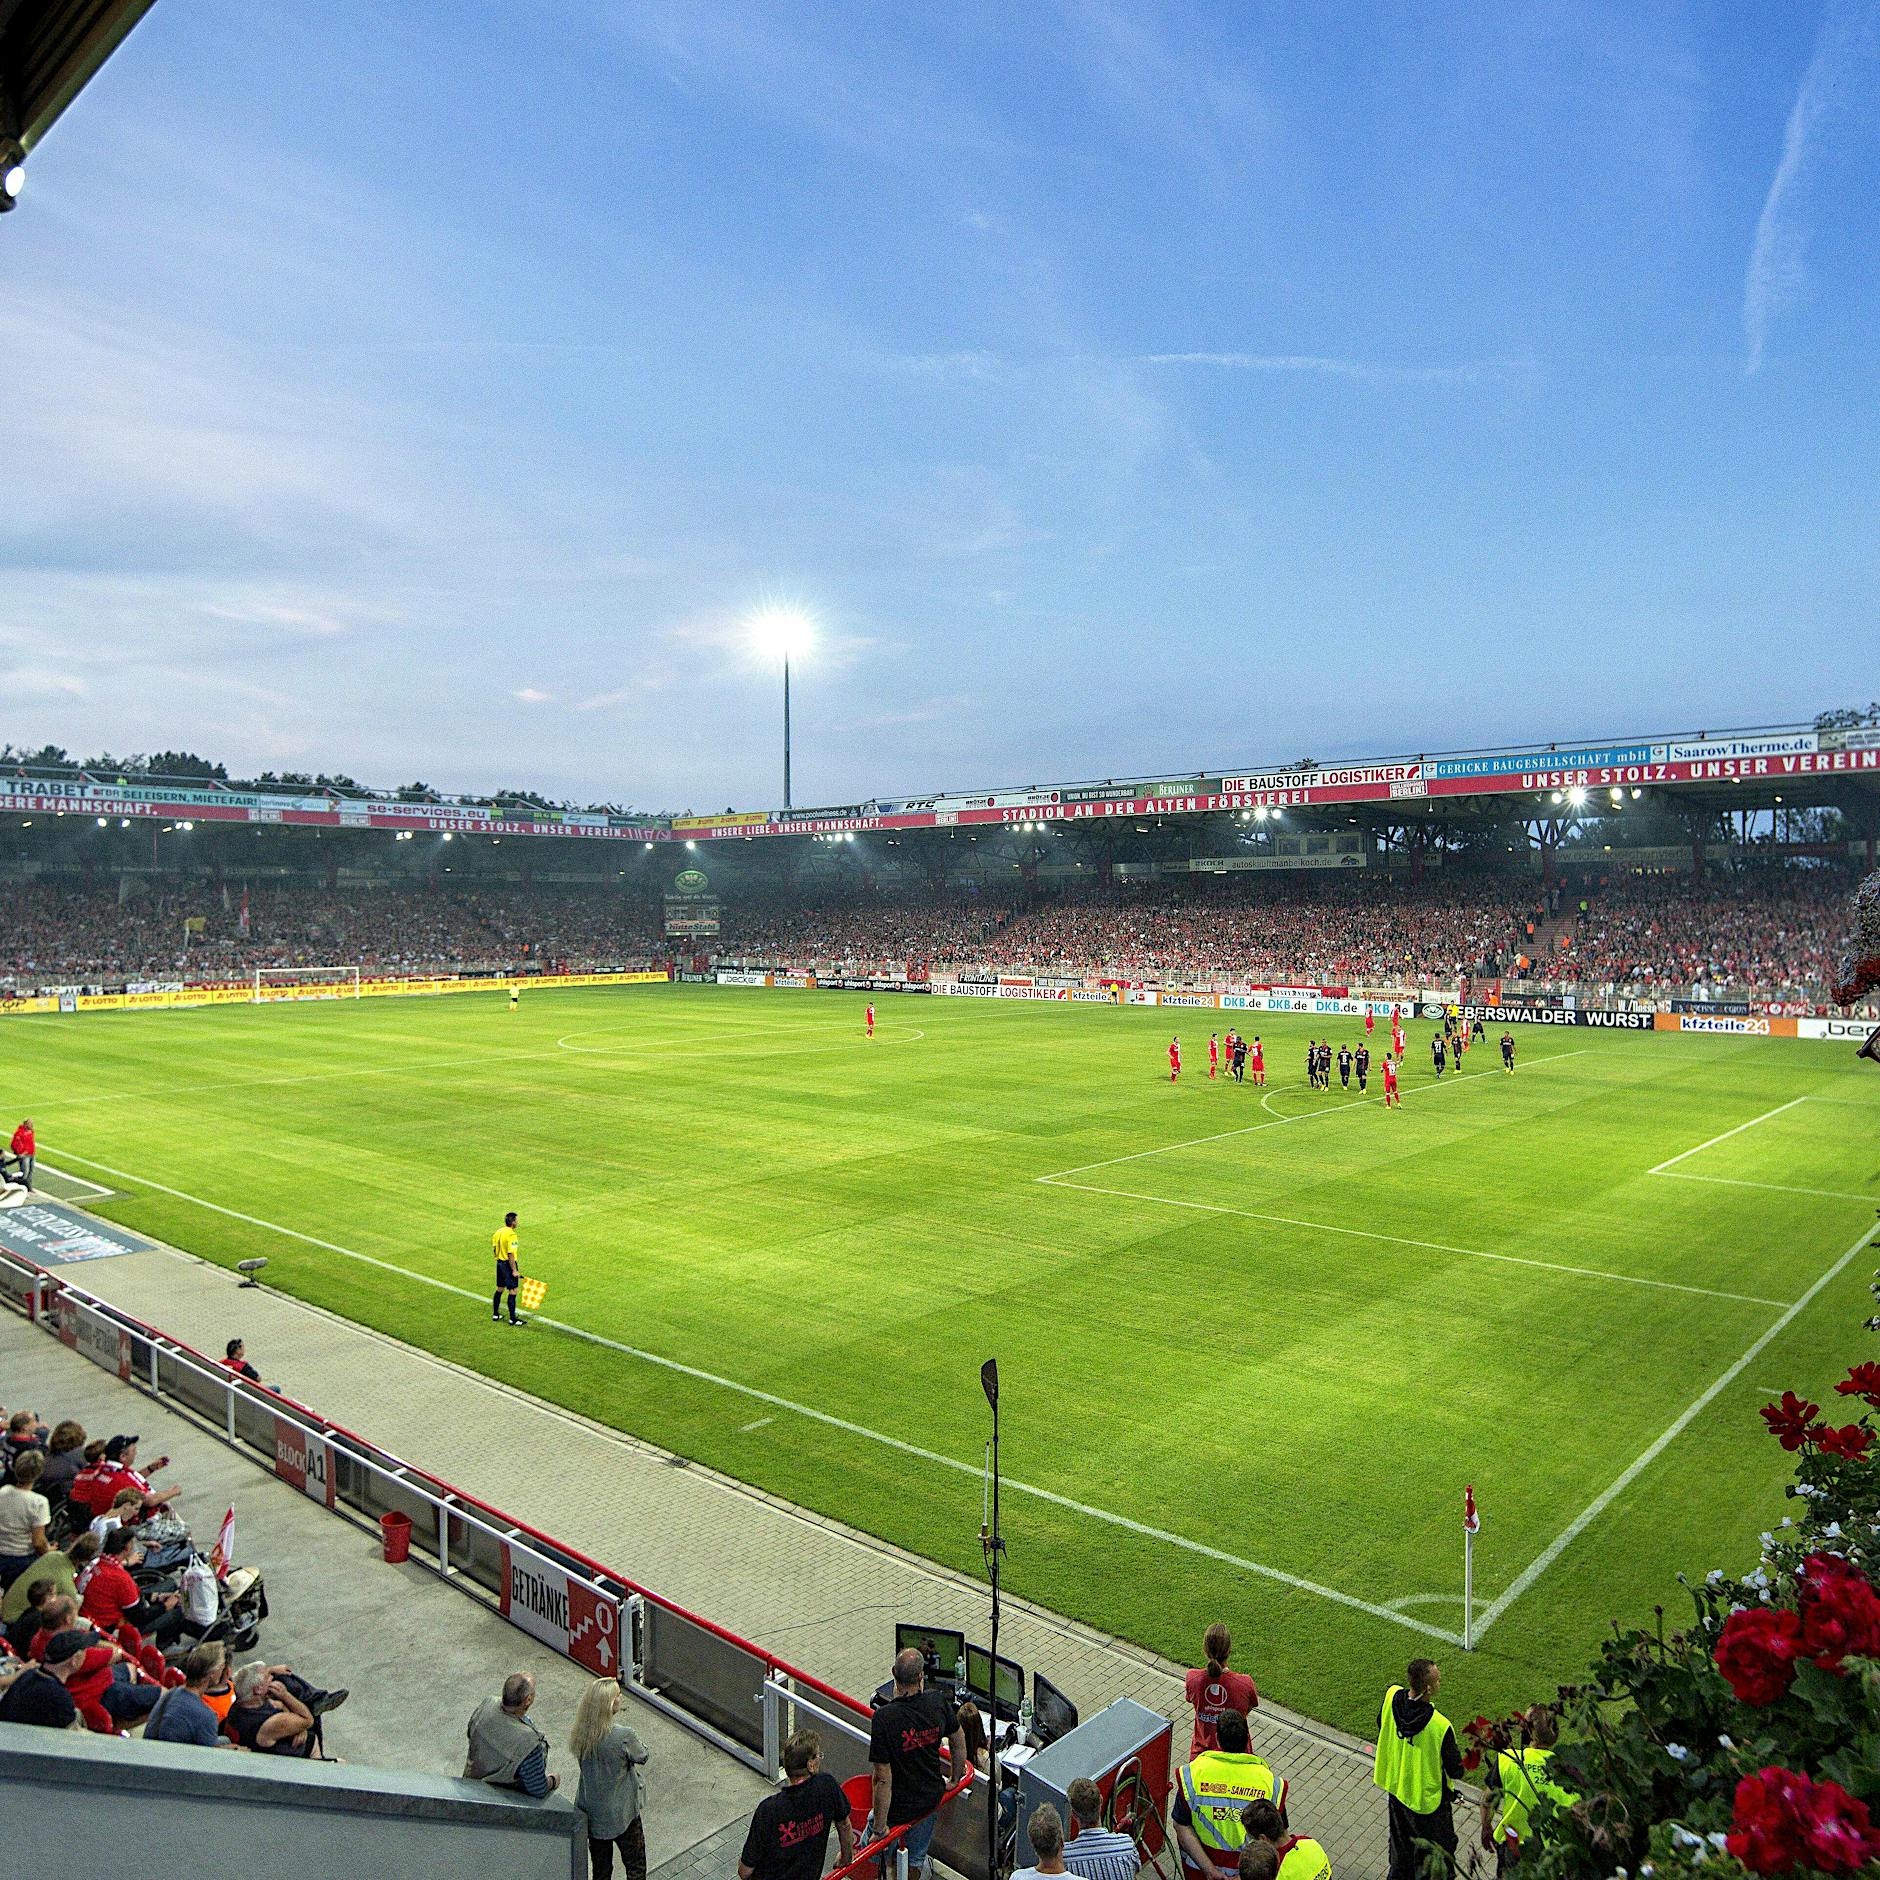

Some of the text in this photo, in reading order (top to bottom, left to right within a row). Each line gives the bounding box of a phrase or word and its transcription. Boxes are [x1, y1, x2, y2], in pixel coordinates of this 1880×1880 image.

[1673, 738, 1813, 759] SaarowTherme.de
[1439, 750, 1646, 774] GERICKE BAUGESELLSCHAFT mbH
[1690, 750, 1877, 778] UNSER VEREIN
[1224, 767, 1405, 792] DIE BAUSTOFF LOGISTIKER
[1522, 765, 1677, 788] UNSER STOLZ.
[6, 781, 89, 797] TRABET
[1160, 784, 1195, 796] BERLINER
[0, 796, 158, 815] ERE MANNSCHAFT.
[367, 804, 486, 818] se-services.eu
[905, 800, 937, 810] RTC
[1002, 789, 1310, 821] STADION AN DER ALTEN FÖRSTEREI
[429, 818, 473, 830] UNSER
[480, 821, 526, 833] STOLZ.
[533, 823, 572, 836] UNSER
[579, 826, 627, 838] VEREIN.
[711, 817, 884, 837] UNSERE LIEBE. UNSERE MANNSCHAFT.
[959, 973, 996, 983] FRONTLINE
[932, 984, 1056, 999] DIE BAUSTOFF LOGISTIKER
[1073, 991, 1114, 1001] kfzteile2
[1162, 995, 1214, 1008] kfzteile24
[1223, 997, 1262, 1009] DKB.de
[1268, 998, 1308, 1010] DKB.de
[1316, 1001, 1358, 1013] DKB.de
[1586, 1010, 1651, 1029] WURST
[1682, 1018, 1768, 1034] kfzteile24
[278, 1439, 307, 1473] BLOCK
[307, 1448, 326, 1485] A1
[512, 1565, 569, 1632] GETRÄNKE
